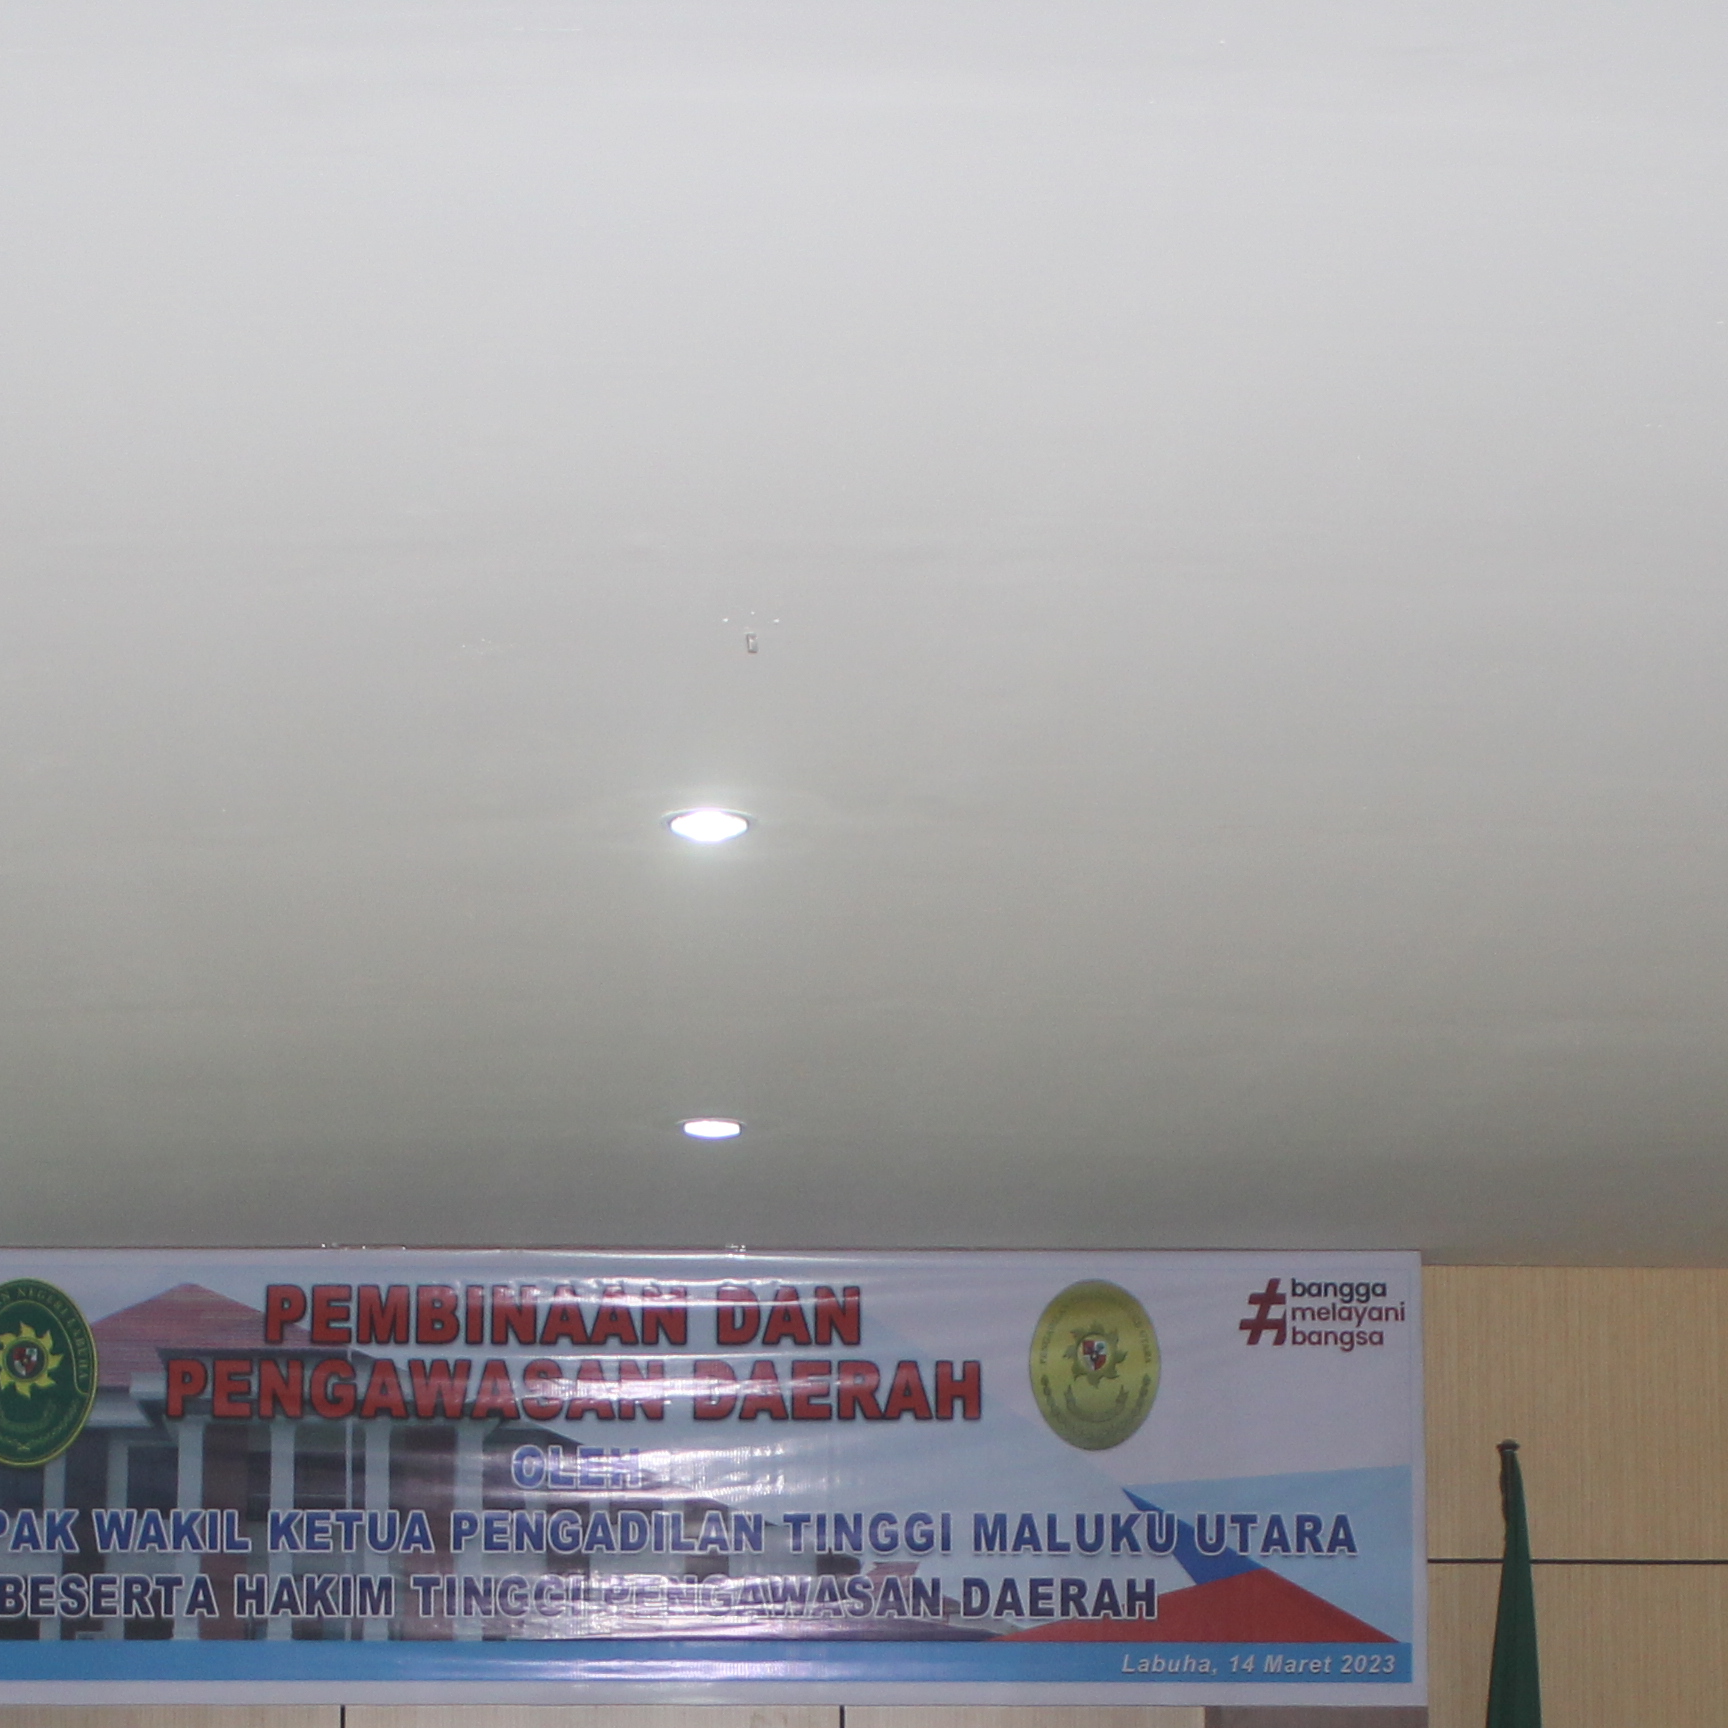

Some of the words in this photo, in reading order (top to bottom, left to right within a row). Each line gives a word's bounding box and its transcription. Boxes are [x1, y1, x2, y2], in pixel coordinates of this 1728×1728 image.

[1291, 1278, 1387, 1303] bangga
[265, 1284, 687, 1345] PEMBINAAN
[716, 1285, 860, 1346] DAN
[1291, 1301, 1405, 1328] melayani
[1291, 1326, 1384, 1352] bangsa
[166, 1358, 665, 1420] PENGAWASAN
[693, 1360, 981, 1421] DAERAH
[511, 1444, 642, 1489] OLEH
[92, 1508, 251, 1554] WAKIL
[268, 1509, 435, 1554] KETUA
[450, 1509, 765, 1555] PENGADILAN
[783, 1511, 952, 1555] TINGGI
[972, 1511, 1178, 1556] MALUKU
[1195, 1512, 1359, 1557] UTARA
[234, 1573, 395, 1619] HAKIM
[411, 1573, 585, 1619] TINGGI
[604, 1573, 945, 1620] PENGAWASAN
[961, 1576, 1158, 1620] DAERAH
[1122, 1653, 1218, 1676] Labuha,
[1229, 1654, 1256, 1674] 14
[1263, 1654, 1332, 1674] Maret
[1340, 1654, 1397, 1675] 2023
